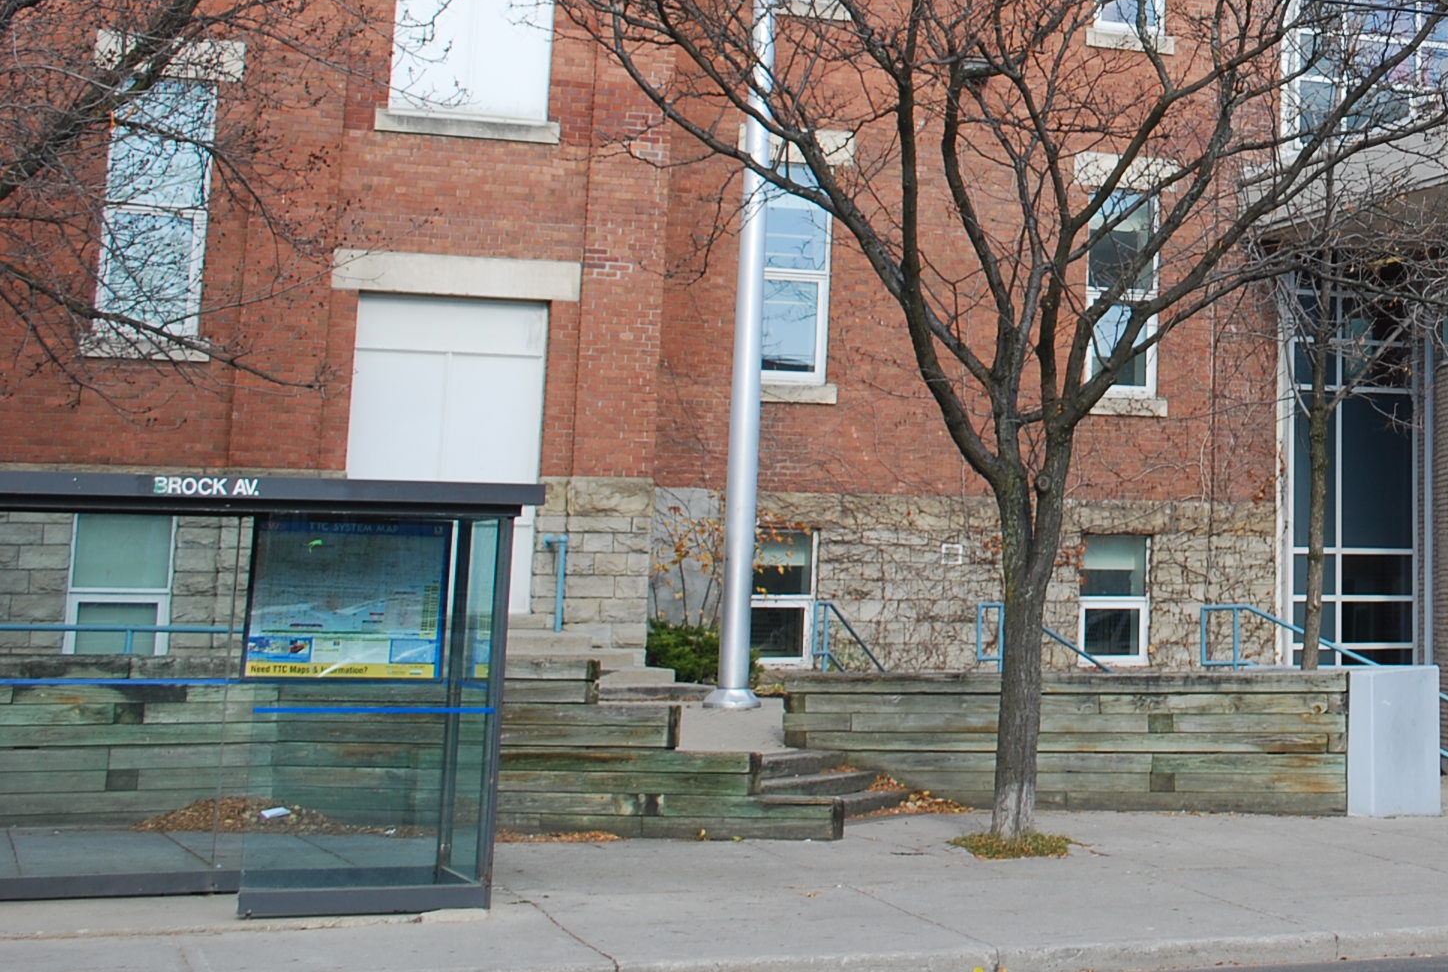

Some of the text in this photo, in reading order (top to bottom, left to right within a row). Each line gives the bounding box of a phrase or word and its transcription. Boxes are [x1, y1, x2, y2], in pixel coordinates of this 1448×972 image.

[153, 476, 260, 496] BROCK AV.
[250, 665, 271, 674] Need
[273, 664, 288, 674] TTC
[289, 665, 310, 675] Maps
[321, 665, 368, 675] Iormation?
